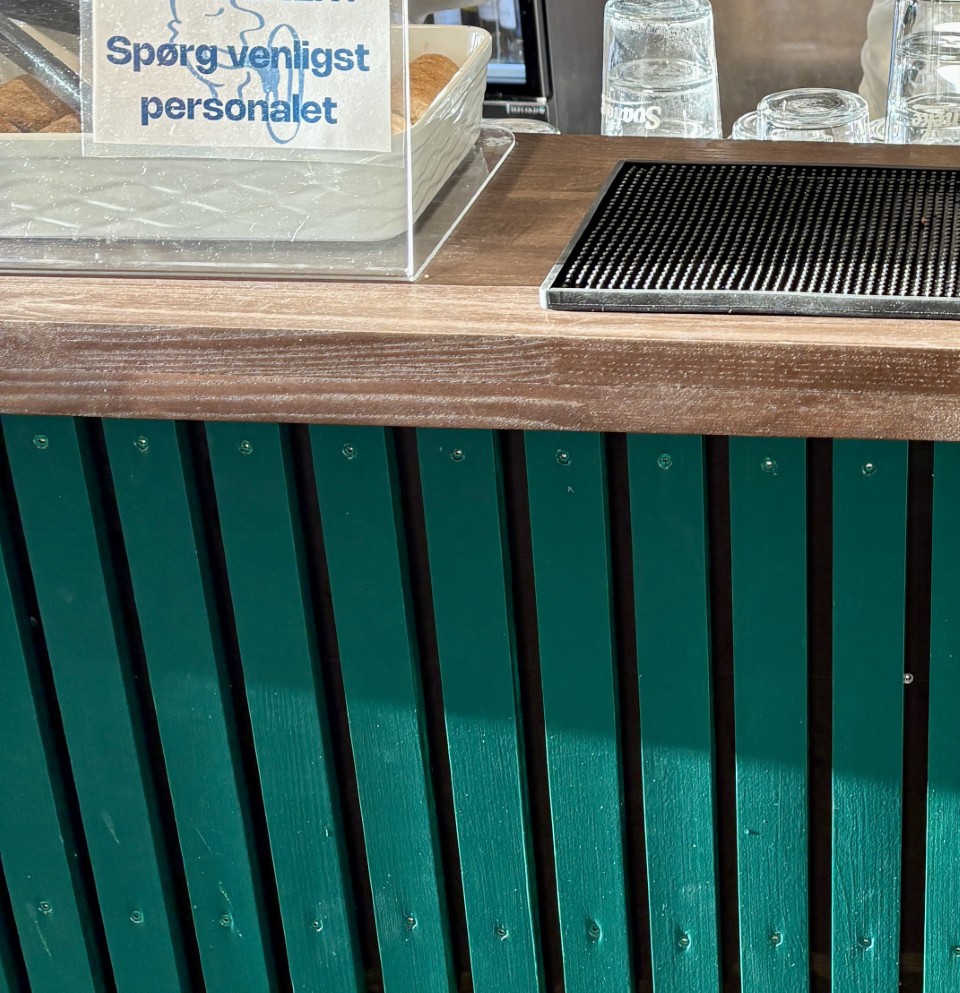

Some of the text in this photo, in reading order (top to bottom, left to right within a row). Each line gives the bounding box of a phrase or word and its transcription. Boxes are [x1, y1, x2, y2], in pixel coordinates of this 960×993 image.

[106, 35, 371, 78] Spørg venligst
[141, 94, 339, 126] personalet
